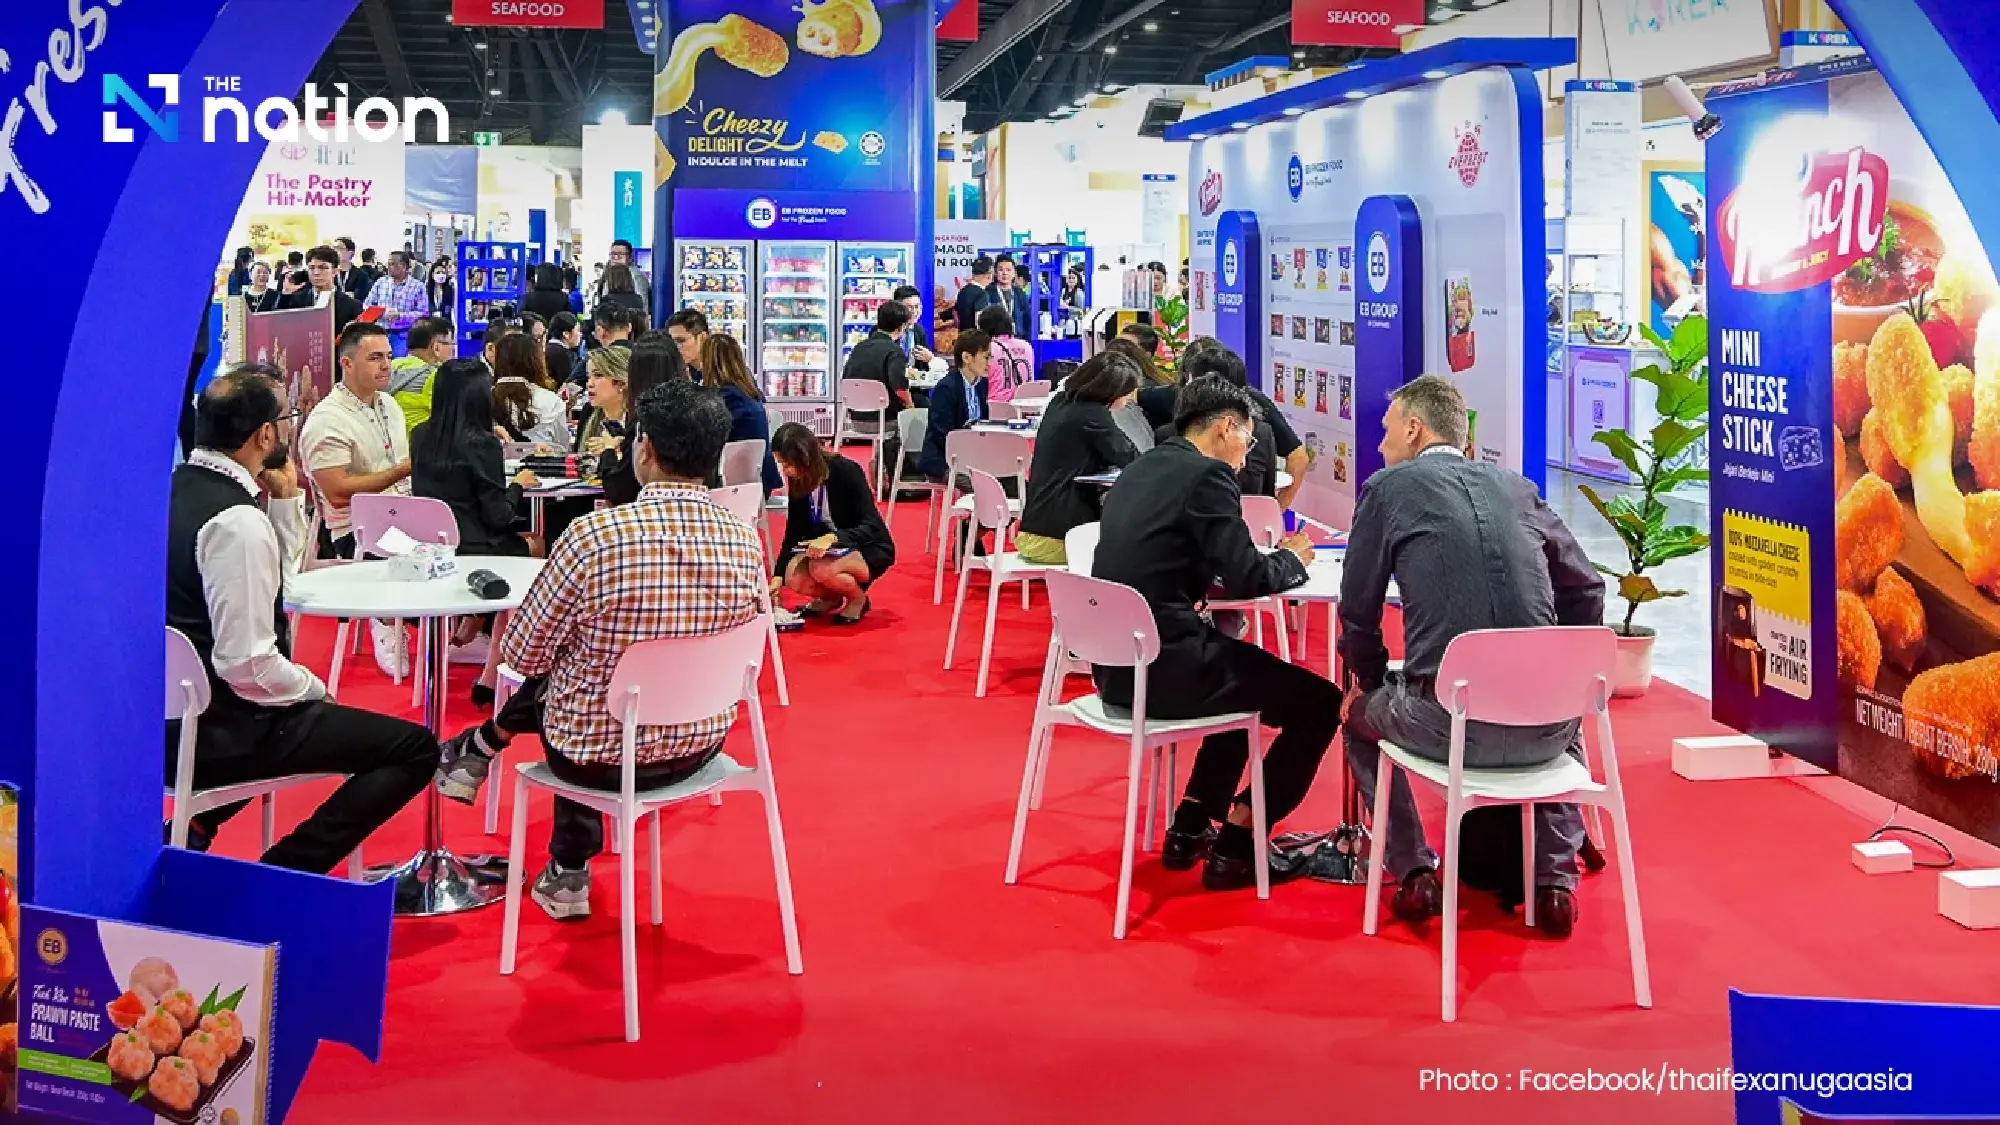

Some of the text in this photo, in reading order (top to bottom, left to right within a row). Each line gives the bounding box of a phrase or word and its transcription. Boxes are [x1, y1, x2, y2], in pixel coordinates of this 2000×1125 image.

[492, 2, 564, 16] SEAFOOD
[1328, 11, 1391, 26] SEAFOOD
[703, 108, 798, 147] Cheezy
[688, 136, 744, 153] DELIGHT
[688, 157, 809, 167] INDULGE IN THE MELT
[265, 172, 373, 194] The Pastry
[267, 191, 371, 207] Hit-Maker
[753, 208, 772, 221] EB
[825, 207, 848, 216] FOOD
[935, 245, 974, 255] MADE
[1371, 251, 1386, 277] EB
[1359, 302, 1399, 318] EB GROUP
[1721, 328, 1760, 367] MINI
[1722, 371, 1788, 415] CHEESE
[1722, 413, 1775, 457] STICK
[1778, 542, 1801, 563] CHEESE
[1788, 636, 1808, 660] AIR
[1770, 653, 1807, 686] FRYING
[1856, 698, 1872, 726] NET
[1871, 704, 1903, 740] WEIGHT
[43, 938, 61, 954] EB
[31, 1002, 101, 1032] PRAWN PASTE
[30, 1022, 55, 1043] BALL
